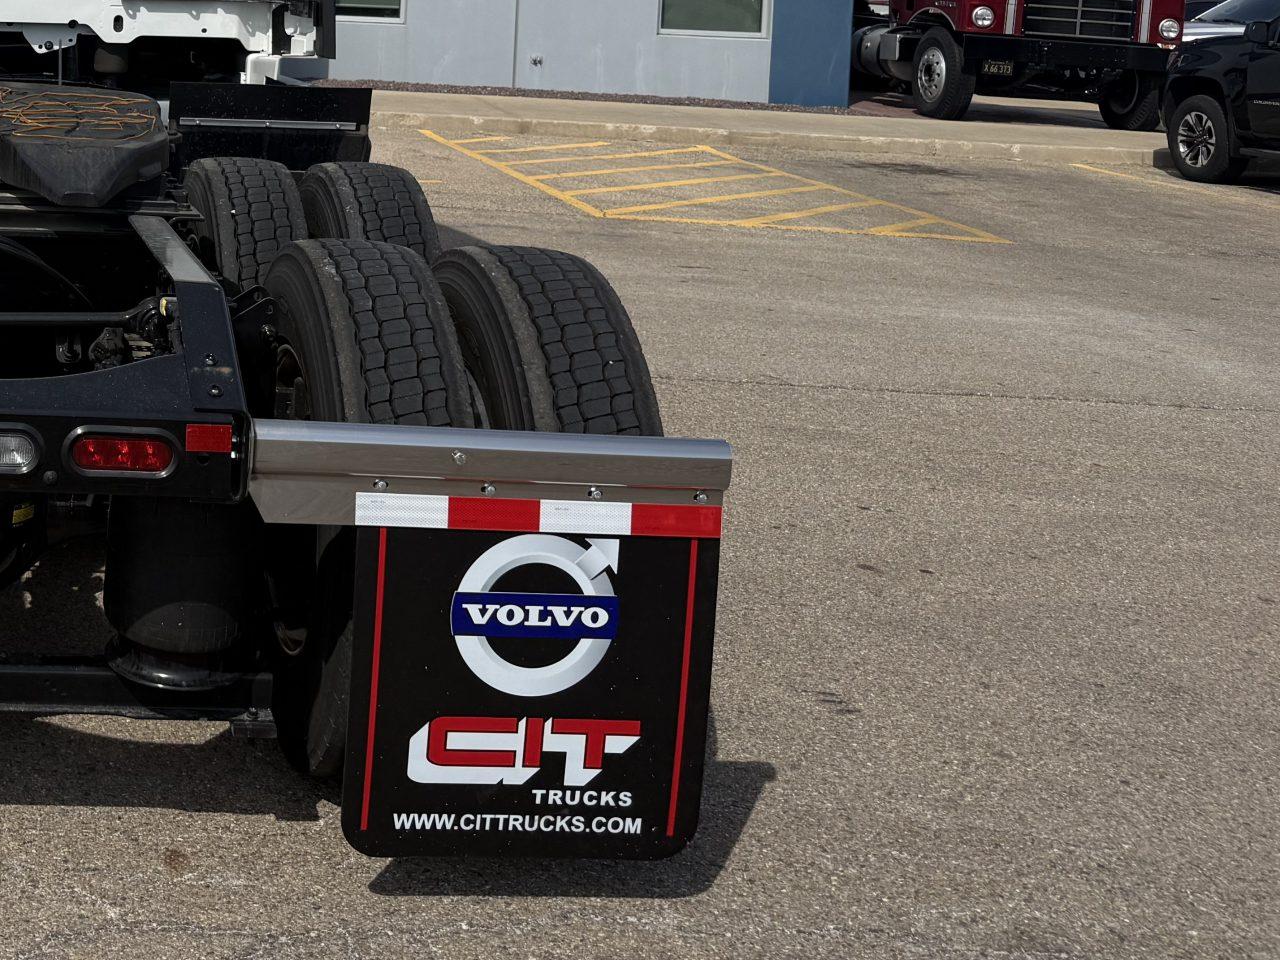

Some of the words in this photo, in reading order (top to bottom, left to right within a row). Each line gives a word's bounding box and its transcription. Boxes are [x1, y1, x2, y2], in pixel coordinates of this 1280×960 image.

[462, 604, 608, 627] VOLVO
[407, 717, 640, 786] CIT
[532, 790, 631, 806] TRUCKS
[394, 814, 641, 833] WWW.CITTRUCKS.COM
